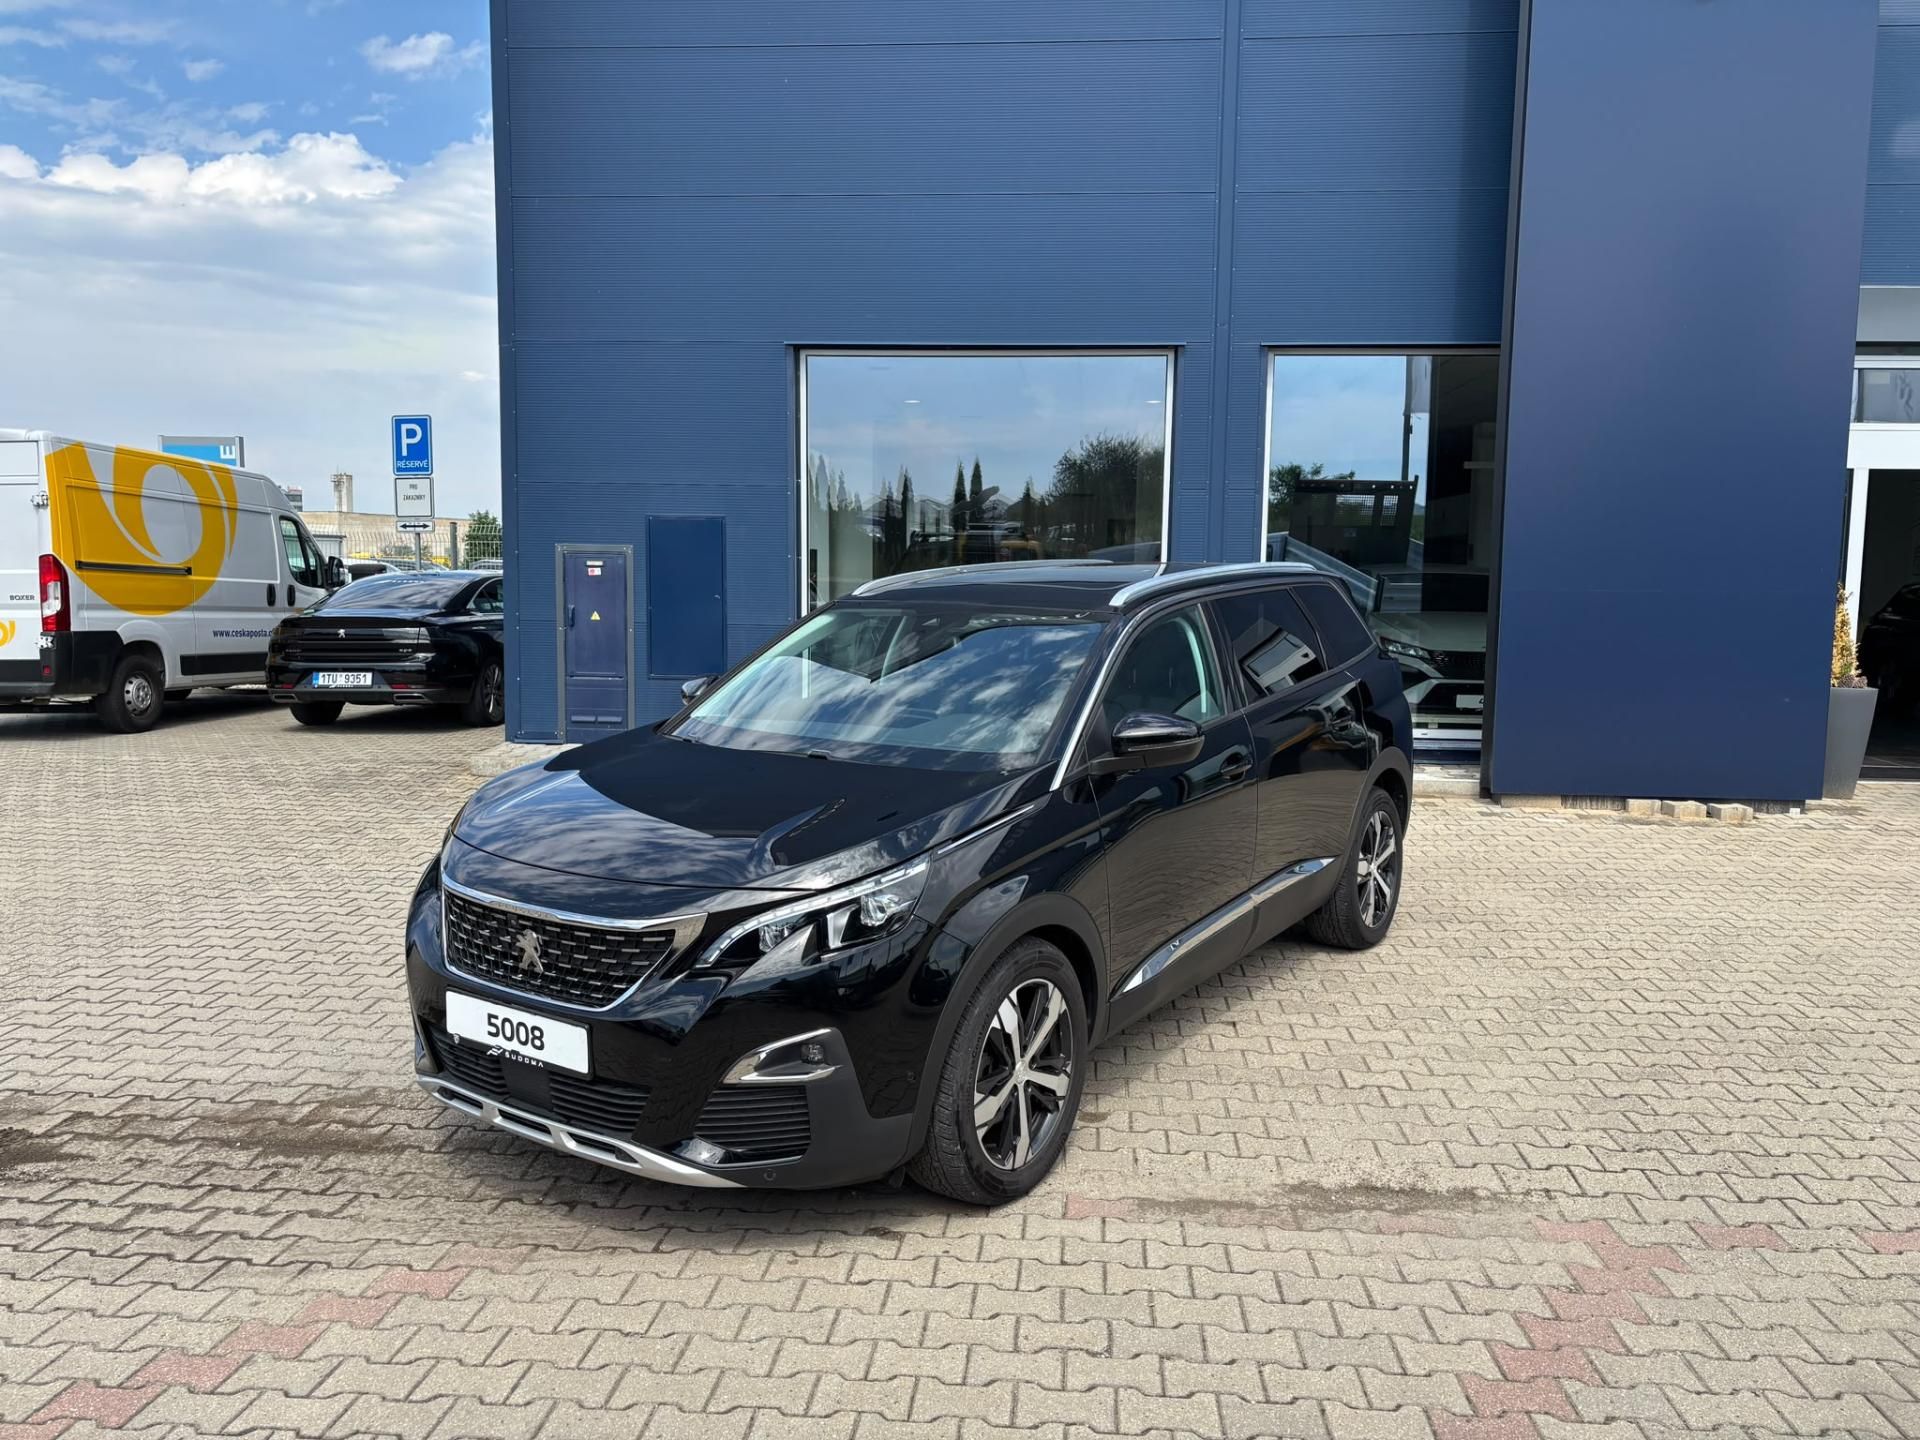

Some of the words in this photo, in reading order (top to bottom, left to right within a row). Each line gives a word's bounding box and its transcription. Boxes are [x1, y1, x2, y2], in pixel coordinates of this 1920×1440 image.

[401, 423, 422, 457] P
[397, 459, 429, 468] RÉSERVÉ
[212, 628, 273, 639] www.ceskaposta.c
[321, 673, 338, 684] 1TU
[344, 673, 367, 684] 9351
[486, 1012, 545, 1051] 5008
